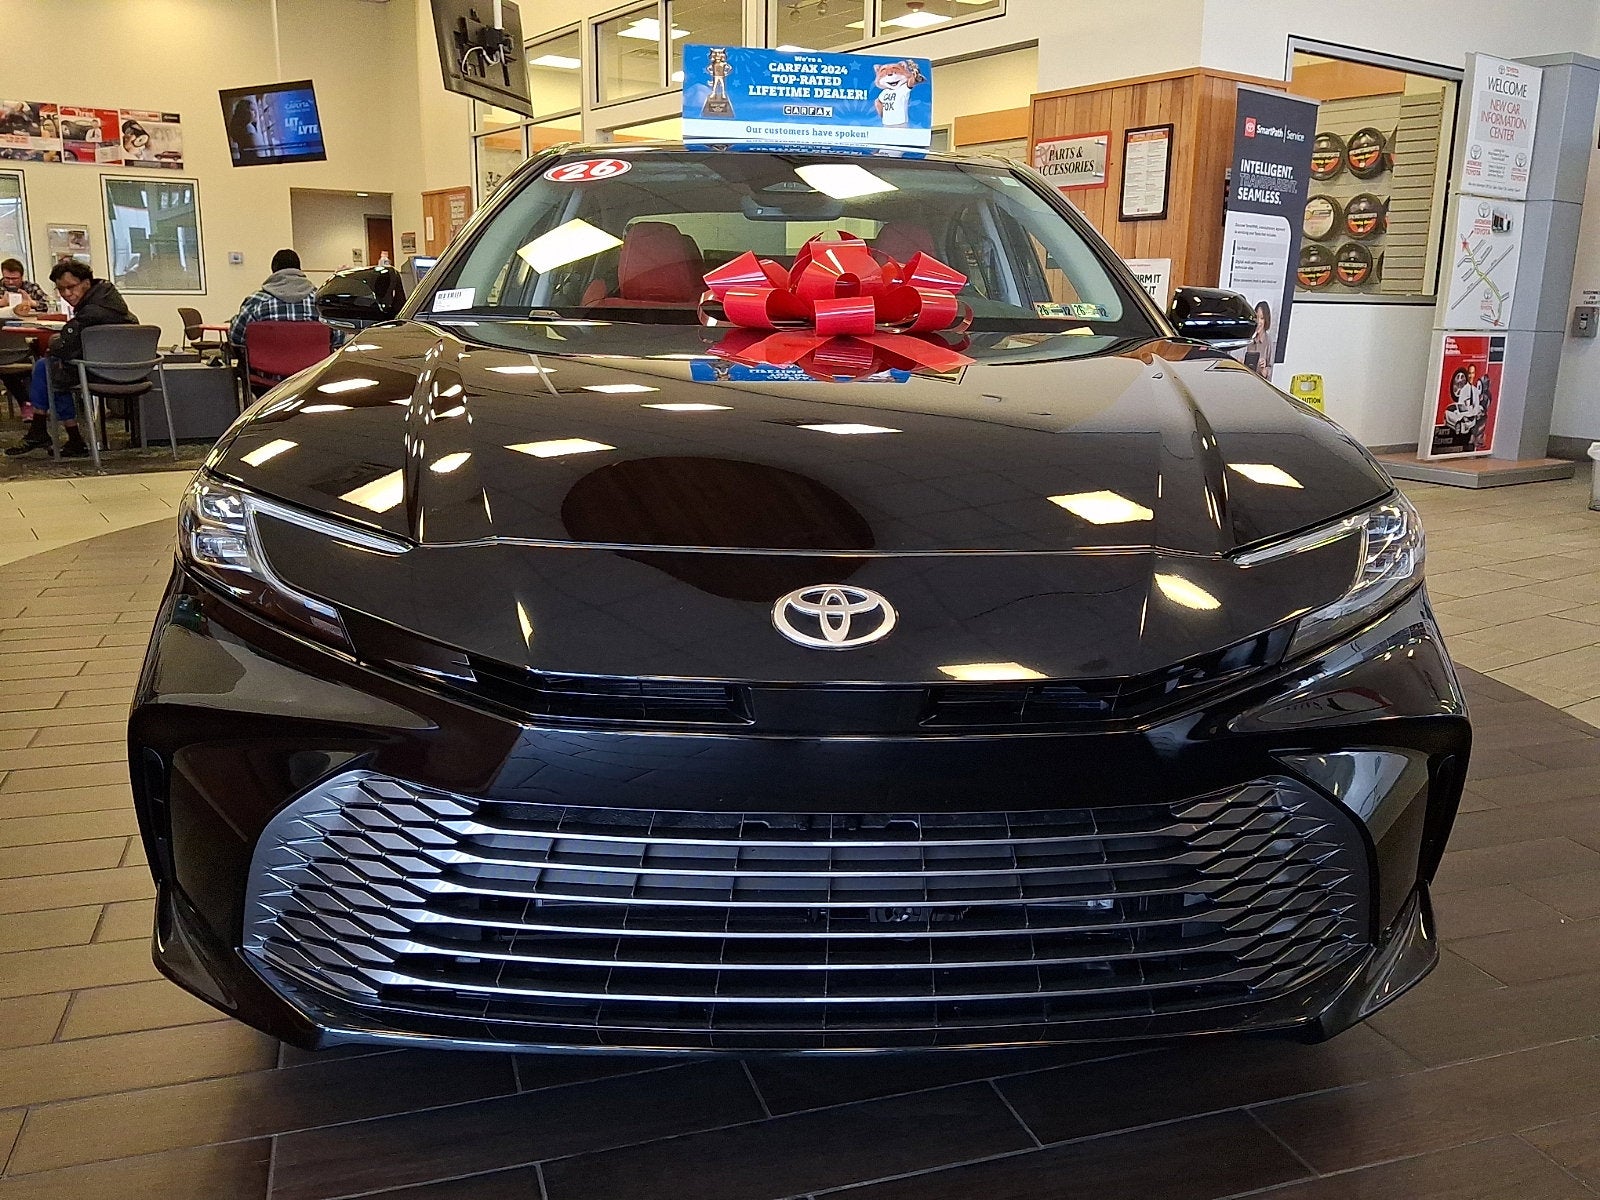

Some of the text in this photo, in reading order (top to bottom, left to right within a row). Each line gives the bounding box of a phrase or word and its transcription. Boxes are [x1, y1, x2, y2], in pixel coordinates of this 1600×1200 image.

[769, 62, 848, 75] CARFAX 2024
[748, 85, 868, 100] LIFETIME DEALER!
[1488, 76, 1527, 98] WELCOME
[883, 92, 897, 101] CAR
[1490, 99, 1520, 115] NEW CAR
[1481, 110, 1527, 130] INFORMATION
[746, 125, 869, 139] Our customers have spoken!
[1256, 124, 1305, 142] SmartPath Service
[1490, 126, 1515, 140] CENTER
[1049, 146, 1083, 161] PARTS &
[558, 160, 617, 180] 26
[1240, 158, 1293, 180] INTELLIGENT.
[1237, 186, 1282, 205] SEAMLESS.
